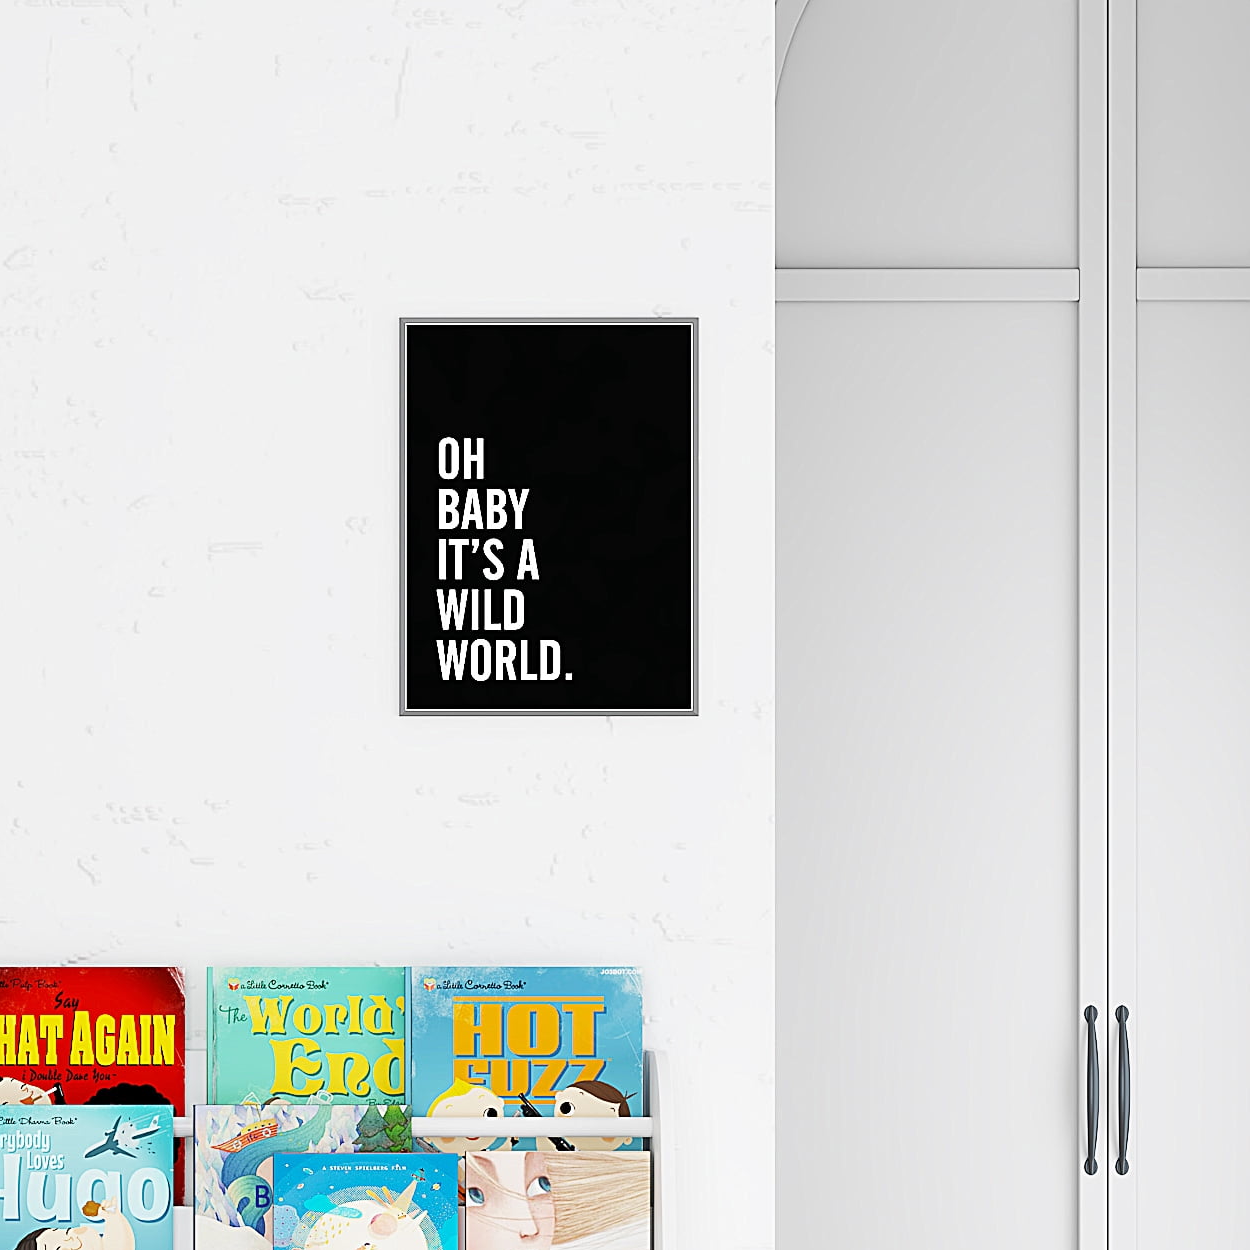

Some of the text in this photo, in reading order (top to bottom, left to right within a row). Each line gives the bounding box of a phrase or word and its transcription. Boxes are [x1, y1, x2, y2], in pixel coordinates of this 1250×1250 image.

[438, 437, 484, 480] OH
[438, 488, 530, 530] BABY
[438, 538, 540, 581] IT’S A
[436, 588, 525, 631] WILD
[436, 639, 573, 682] WORLD.
[11, 978, 33, 991] Pulp
[246, 980, 267, 990] Little
[268, 979, 305, 990] Cornetto
[442, 980, 463, 990] Little
[464, 979, 502, 990] Cornetto
[54, 991, 80, 1010] Say
[219, 1005, 248, 1024] The
[69, 1010, 176, 1067] AGAIN
[453, 1003, 607, 1058] HOT
[29, 1068, 62, 1082] Double
[65, 1068, 89, 1082] Dare
[18, 1116, 50, 1125] Dharma
[26, 1151, 65, 1170] Loves
